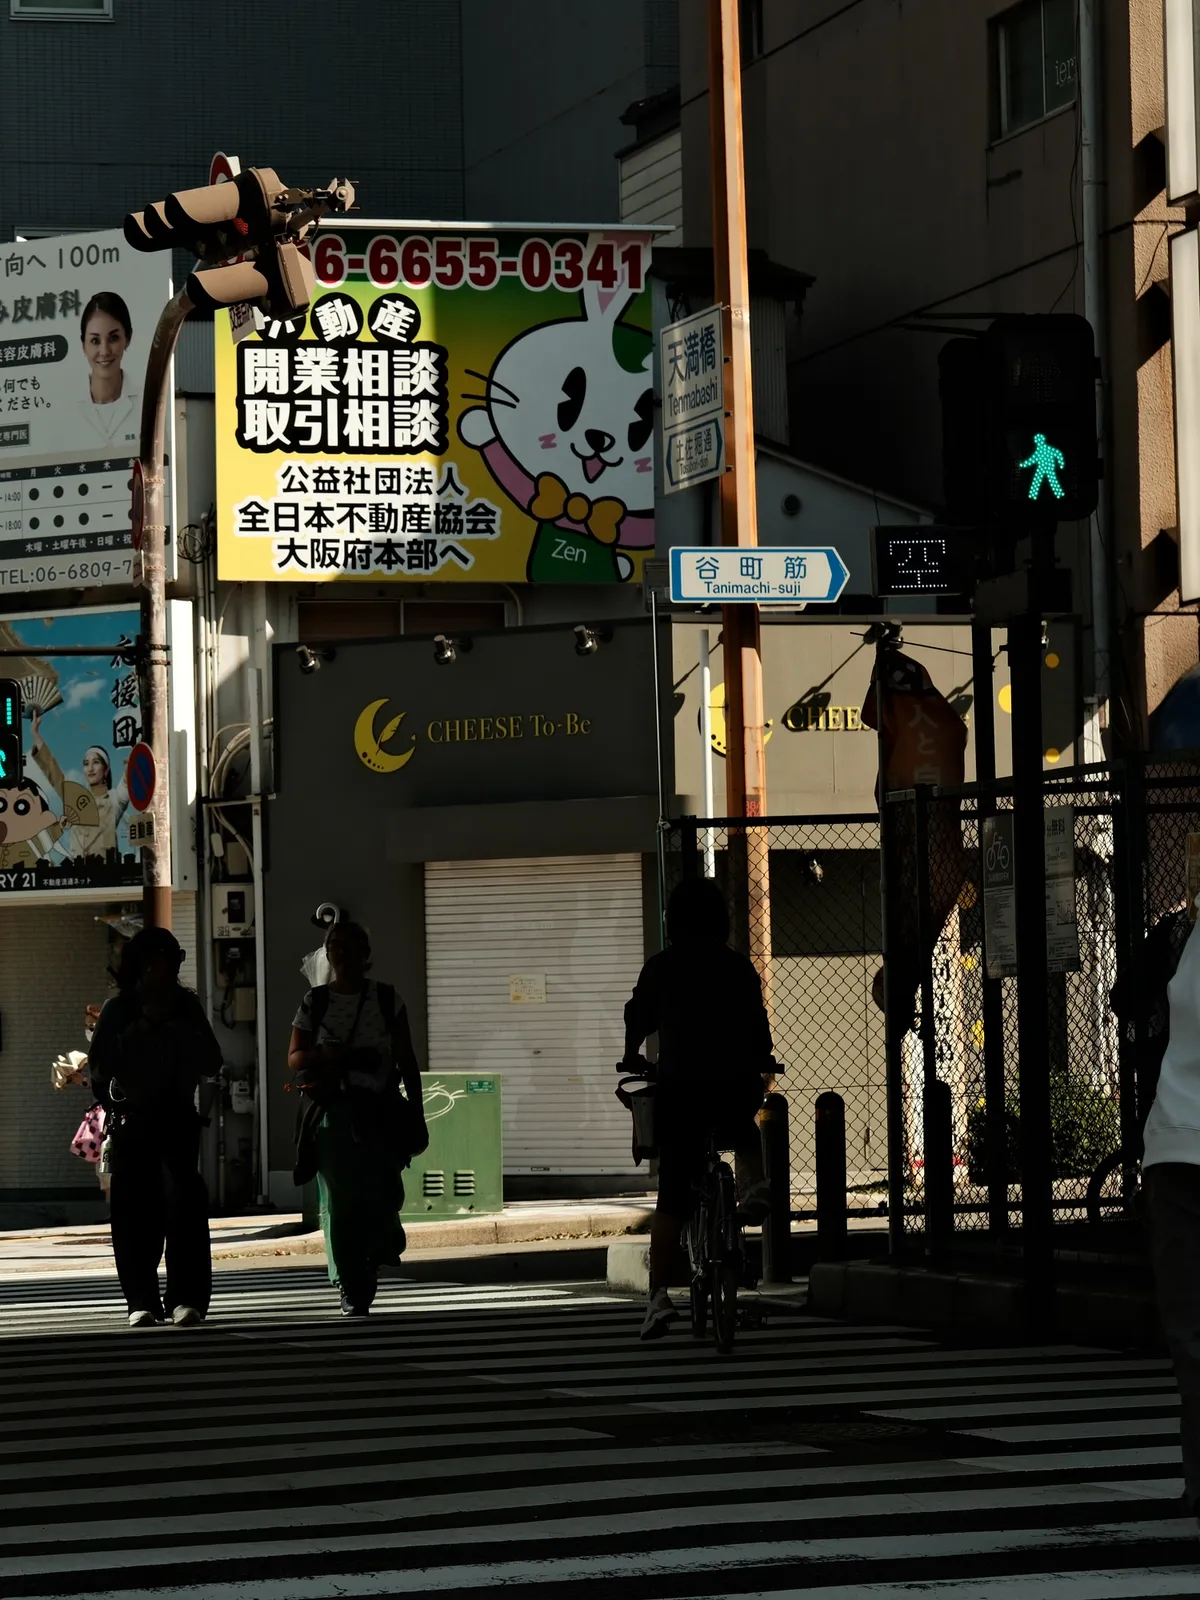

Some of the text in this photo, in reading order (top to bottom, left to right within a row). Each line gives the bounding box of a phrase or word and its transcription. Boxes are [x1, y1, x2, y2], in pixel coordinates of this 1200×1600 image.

[58, 245, 120, 269] 100m
[296, 235, 646, 291] 6-6655-0341
[668, 323, 716, 387] 天満橋
[243, 347, 441, 397] 開業相談
[668, 377, 718, 418] Tenmabashi
[243, 399, 441, 448] 取引相談
[30, 468, 37, 477] 月
[54, 466, 62, 475] 火
[78, 463, 86, 473] 水
[103, 461, 111, 470] 木
[282, 465, 466, 496] 公益社団法人
[238, 501, 498, 535] 全日本不動産協会
[26, 533, 132, 552] 木曜・土曜午後・日曜・祝
[277, 538, 471, 570] 大阪府本部へ
[551, 538, 588, 564] Zen
[696, 556, 808, 580] 谷町筋
[704, 581, 801, 597] Tanimachi-suji
[427, 712, 593, 744] CHEESE To-Be
[786, 706, 869, 729] CHEE
[21, 872, 36, 888] 21
